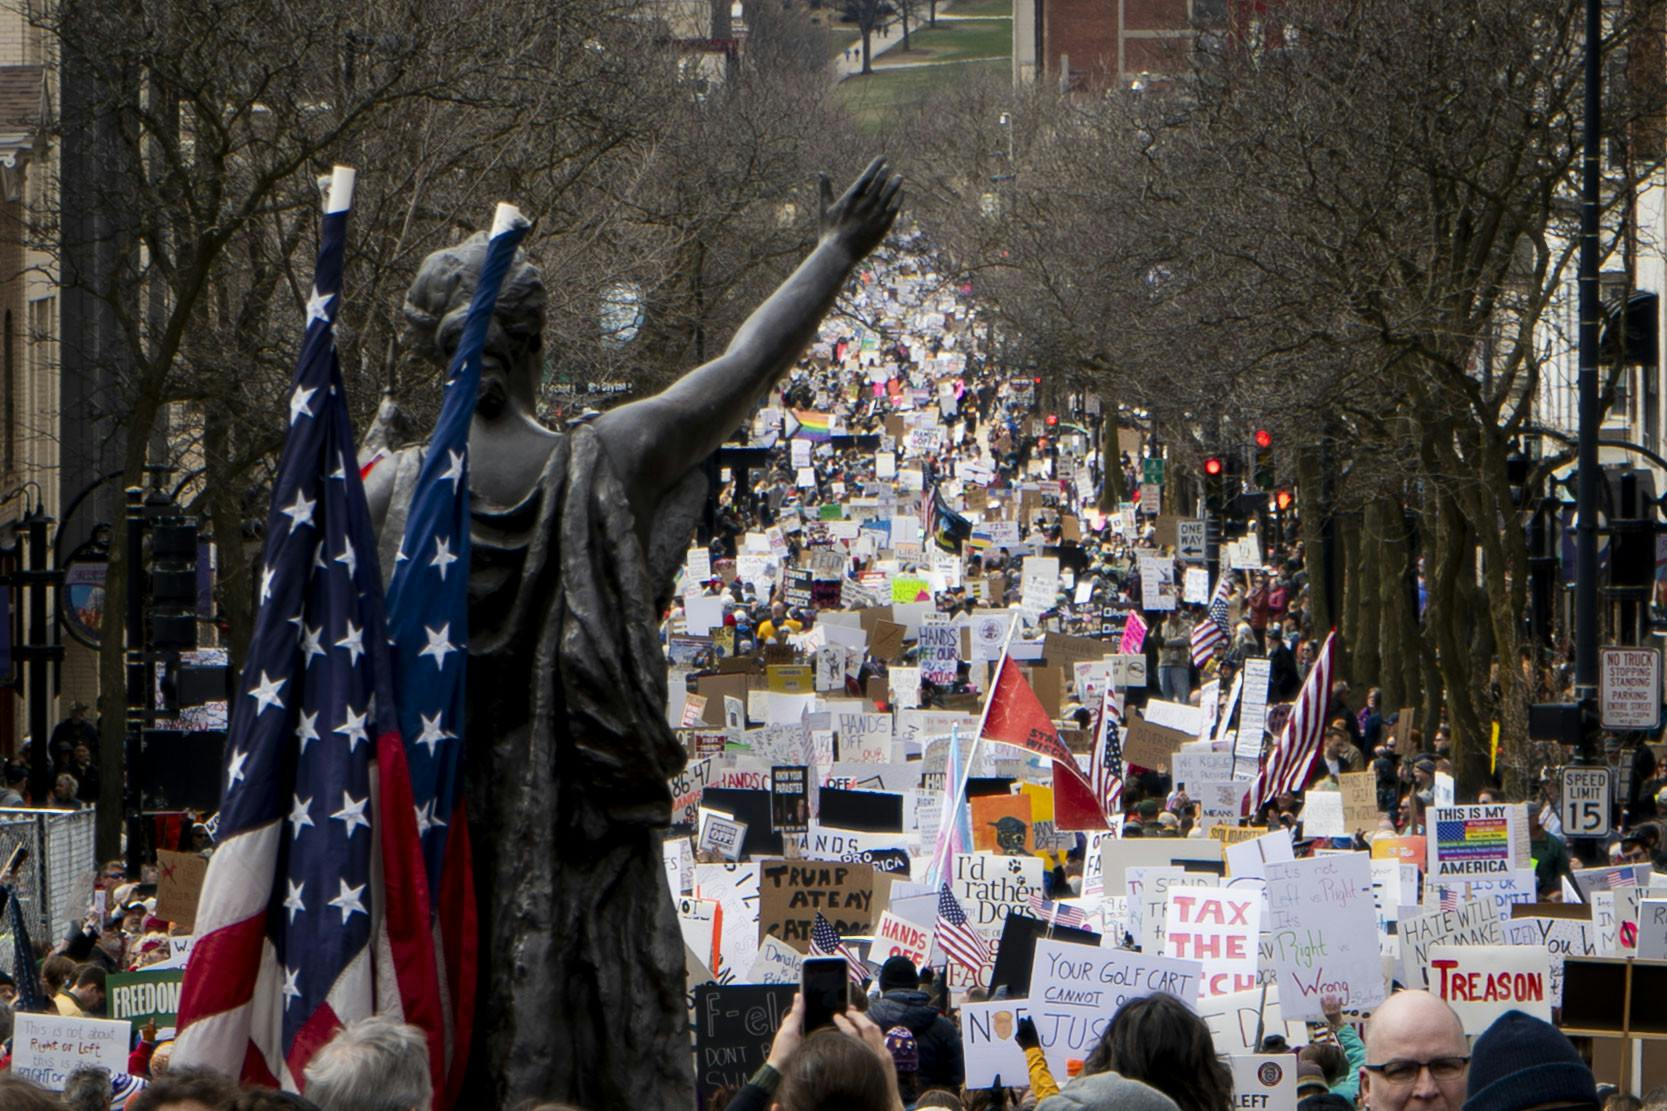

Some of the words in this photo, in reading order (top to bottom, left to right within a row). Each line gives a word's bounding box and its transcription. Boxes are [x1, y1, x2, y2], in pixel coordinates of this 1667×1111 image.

[1180, 535, 1203, 545] WAY
[1181, 525, 1202, 534] ONE
[1607, 653, 1620, 666] NO
[1624, 653, 1653, 666] TRUCK
[1610, 668, 1651, 676] STOPPING
[1610, 678, 1650, 687] STANDING
[1612, 691, 1647, 701] PARKING
[839, 713, 888, 735] HANDS
[841, 735, 865, 750] OFF
[1566, 774, 1606, 787] SPEED
[1570, 787, 1602, 799] LIMIT
[1437, 808, 1465, 820] THIS
[1469, 807, 1481, 818] IS
[1485, 806, 1506, 818] MY
[1569, 803, 1602, 830] 15
[800, 834, 859, 854] ANDS
[872, 856, 905, 872] RICA
[1440, 860, 1508, 874] AMERICA
[765, 865, 849, 888] TRUMP
[789, 890, 840, 909] ATE
[844, 890, 873, 912] MY
[966, 878, 1041, 903] rather
[1173, 896, 1252, 925] TAX
[1403, 910, 1454, 945] HATE
[1455, 897, 1498, 929] WILL
[882, 917, 927, 950] HANDS
[1453, 920, 1500, 946] MAKE
[1537, 919, 1573, 956] You
[1169, 933, 1248, 960] THE
[1274, 929, 1328, 968] Right
[949, 962, 994, 989] FAC
[1047, 952, 1093, 982] YOUR
[1147, 968, 1194, 996] CART
[1431, 959, 1543, 1002] TREASON
[1044, 986, 1103, 1005] CANNOT
[1198, 972, 1255, 998] CH
[1292, 967, 1351, 1006] Wrong
[24, 1021, 47, 1035] This
[53, 1027, 60, 1038] is
[66, 1025, 82, 1039] not
[87, 1027, 116, 1041] about
[30, 1038, 59, 1053] Right
[62, 1042, 73, 1052] or
[78, 1042, 101, 1058] Left
[1233, 1094, 1270, 1109] LEFT
